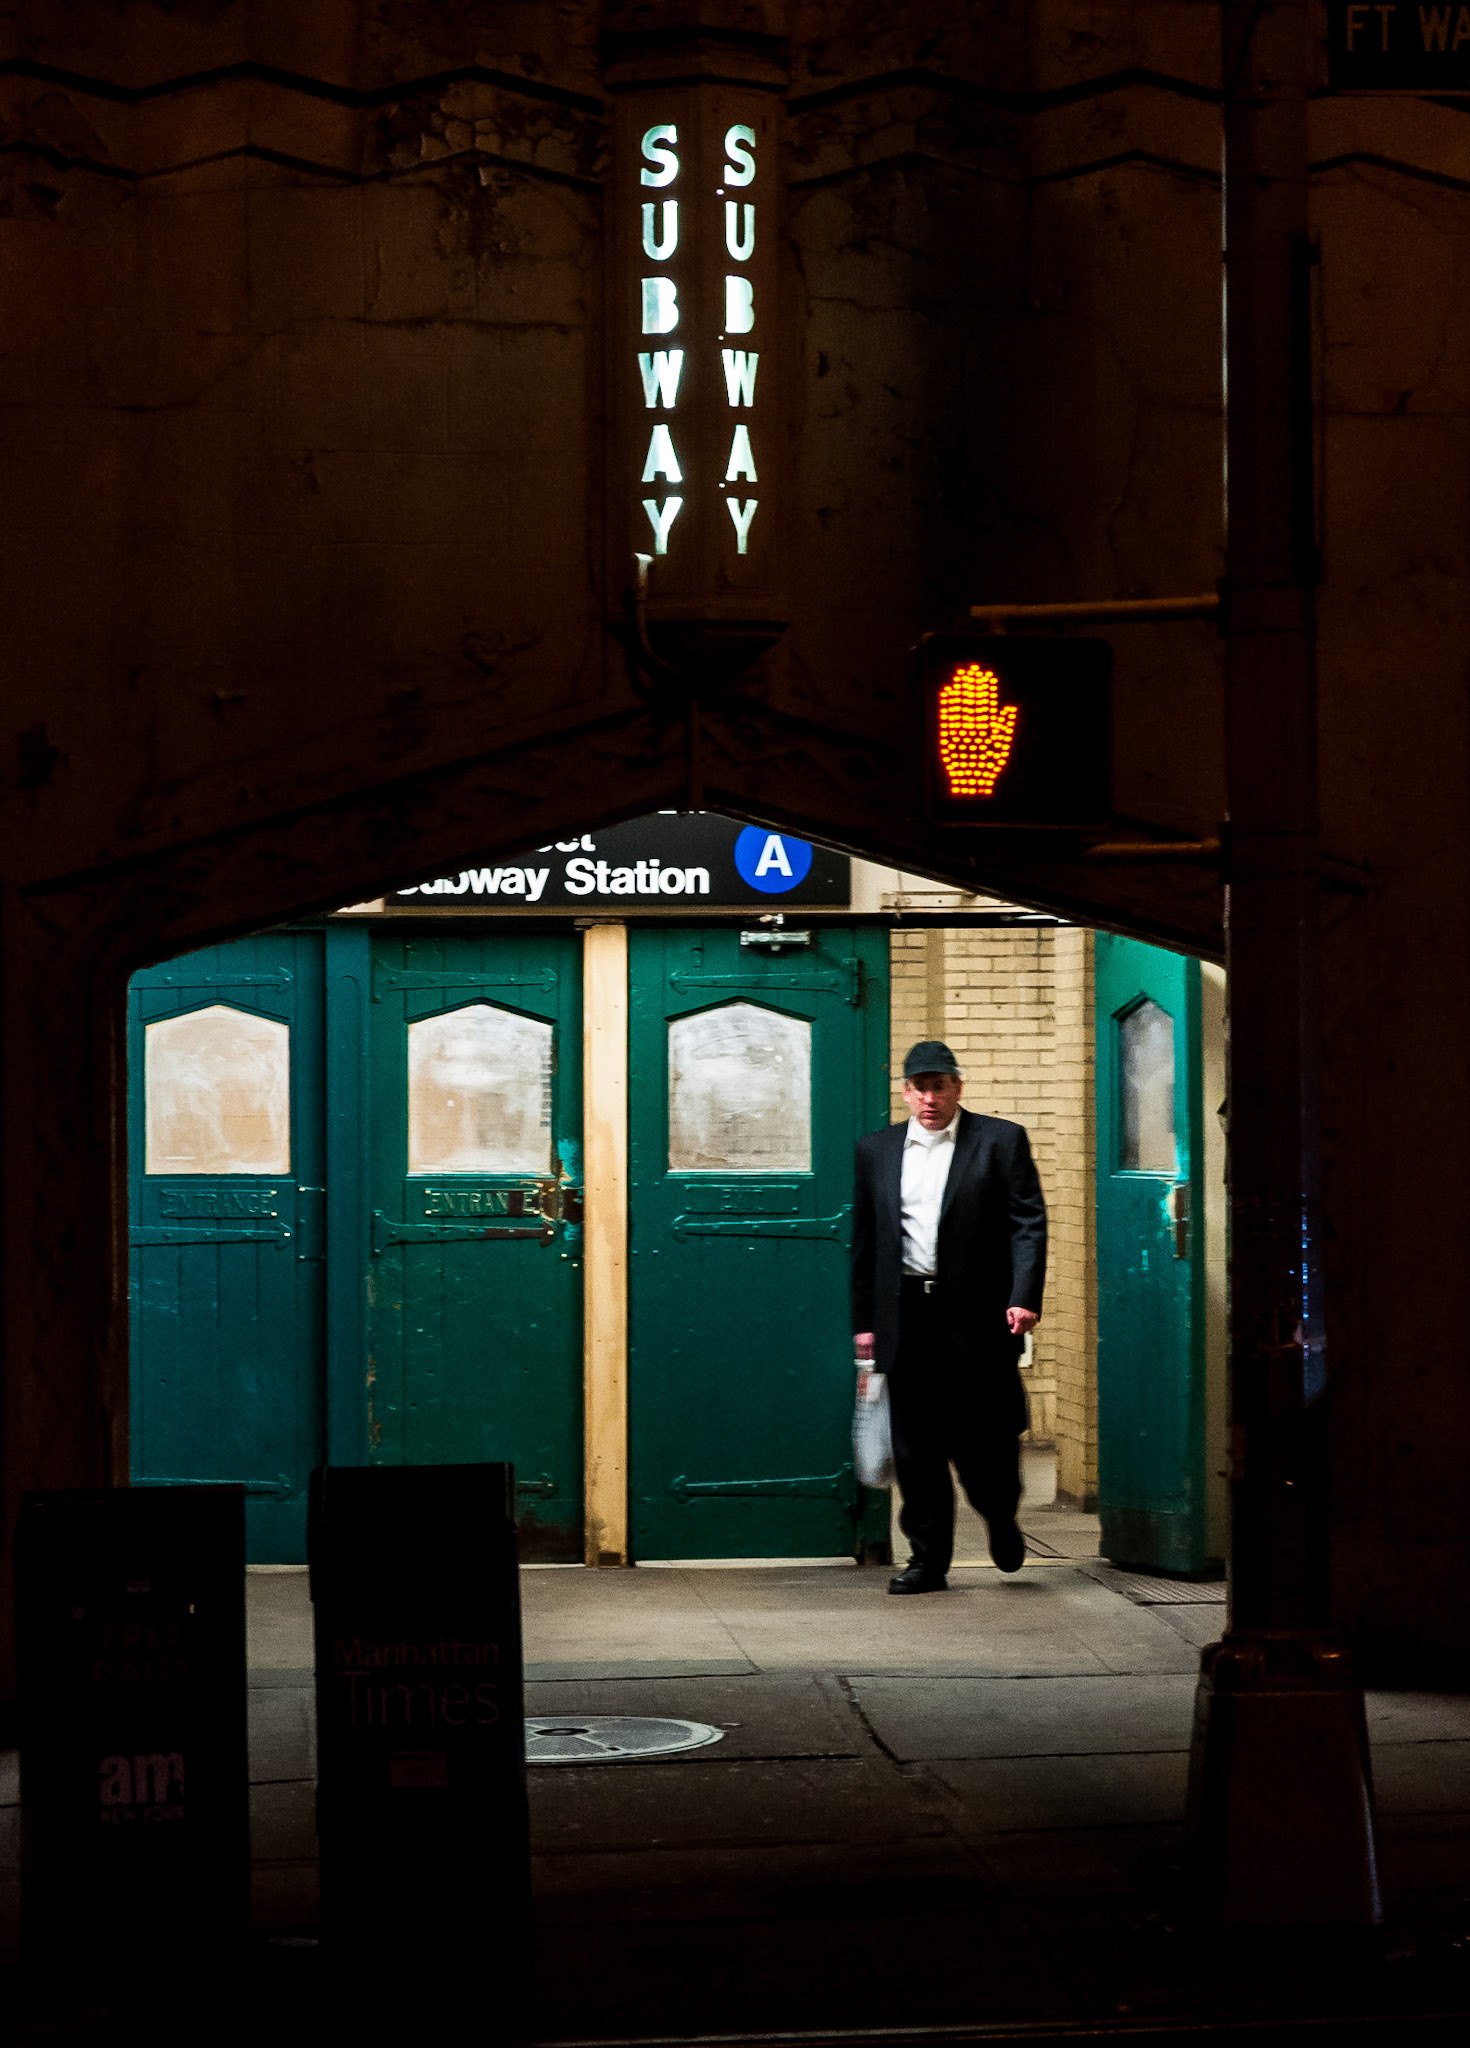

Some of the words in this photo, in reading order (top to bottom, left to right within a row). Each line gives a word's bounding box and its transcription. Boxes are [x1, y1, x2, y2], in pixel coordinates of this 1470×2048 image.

[1345, 4, 1397, 53] FT
[638, 124, 684, 555] SUBWAY
[722, 124, 760, 555] SUBWAY
[564, 857, 711, 896] Station
[754, 834, 794, 877] A
[431, 1192, 540, 1214] ENTRANE
[333, 1635, 501, 1667] Manhattan
[335, 1669, 501, 1727] Times
